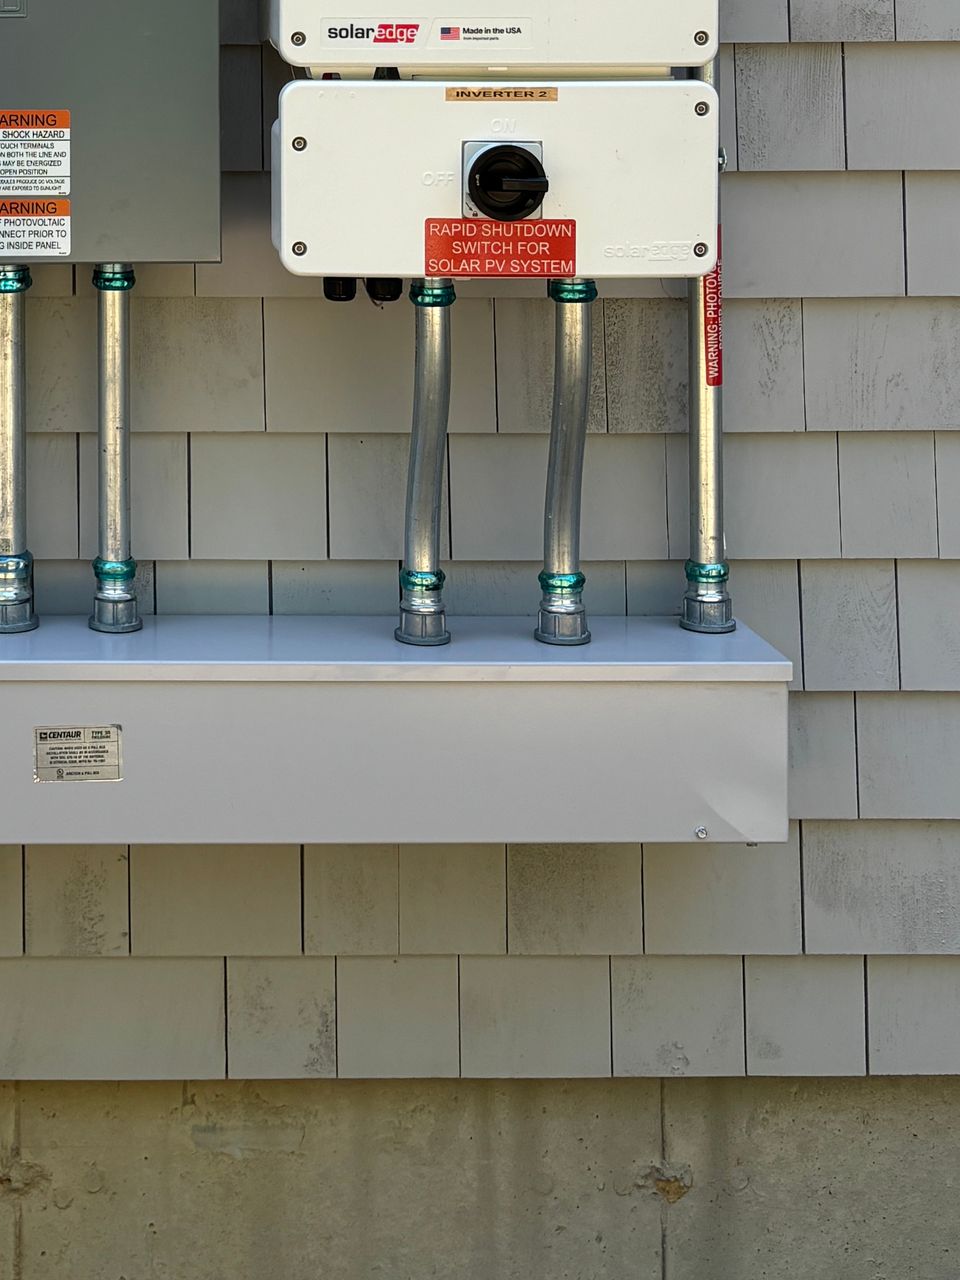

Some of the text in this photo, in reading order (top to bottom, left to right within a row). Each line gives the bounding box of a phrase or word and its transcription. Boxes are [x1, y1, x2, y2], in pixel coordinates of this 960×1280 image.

[327, 23, 418, 42] solaredge
[456, 90, 547, 98] INVERTER 2
[490, 118, 516, 133] ON
[2, 130, 30, 139] SHOCK
[32, 130, 65, 139] HAZARD
[421, 171, 456, 186] OFF
[3, 218, 65, 227] PHOTOVOLTAIC
[27, 230, 53, 238] PRIOR
[55, 230, 66, 238] TO
[430, 223, 572, 238] RAPID SHUTDOWN
[6, 242, 33, 250] INSIDE
[35, 242, 61, 250] PANEL
[452, 241, 550, 255] SWITCH FOR
[428, 259, 573, 273] SOLAR PV SYSTEM
[706, 320, 719, 378] WARNING:
[48, 730, 82, 739] CENTAUR
